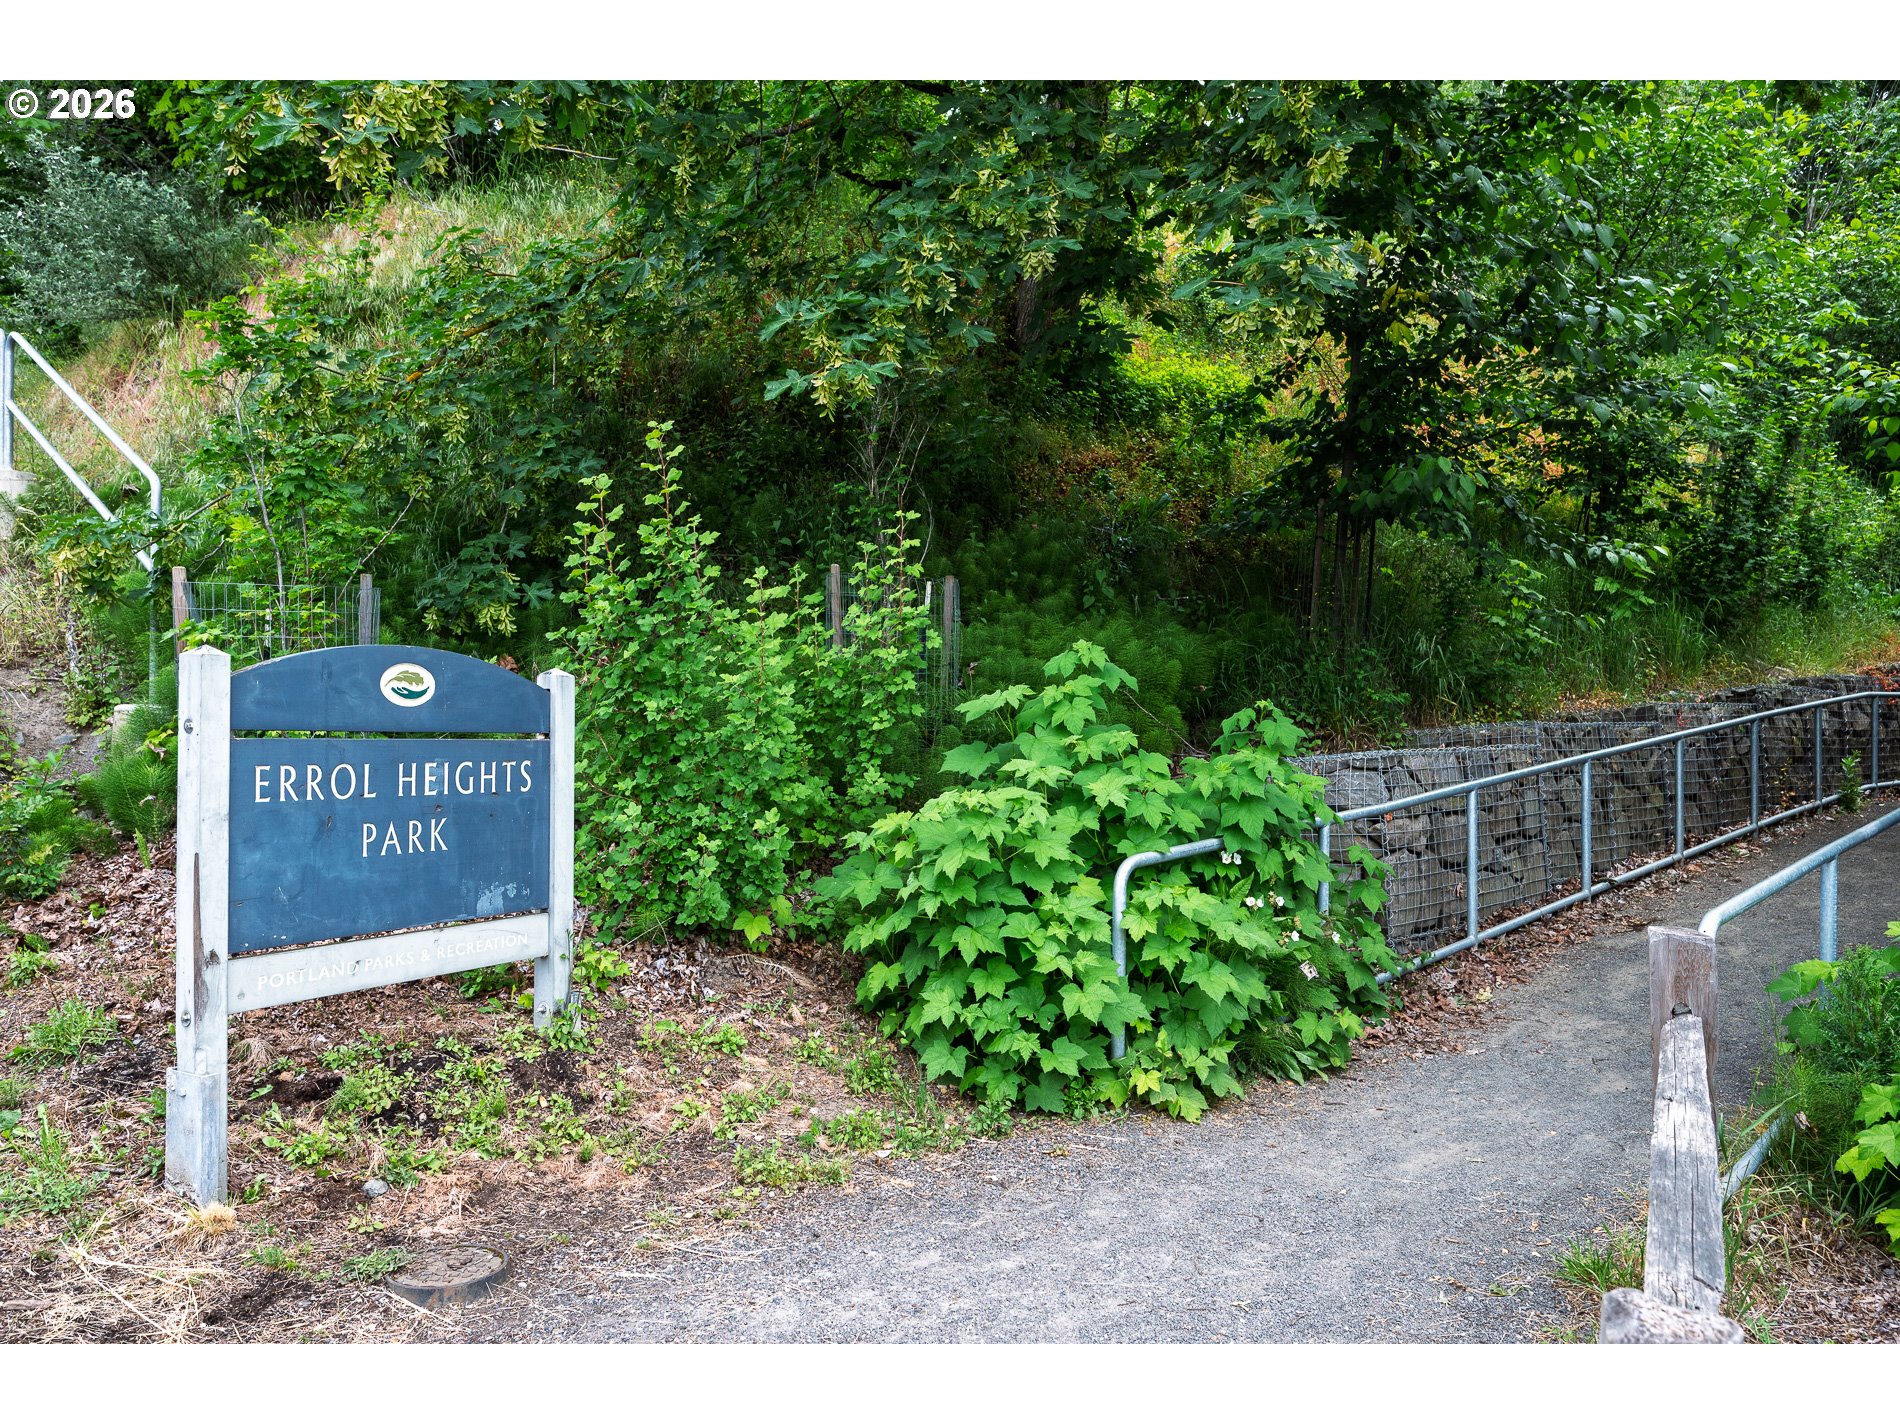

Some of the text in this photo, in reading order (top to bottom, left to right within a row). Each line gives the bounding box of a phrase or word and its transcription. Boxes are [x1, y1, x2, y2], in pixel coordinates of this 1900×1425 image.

[255, 760, 532, 803] ERROL HEIGHTS
[362, 817, 449, 858] PARK
[257, 933, 529, 990] PORTLAND PARKS & RECREATION
